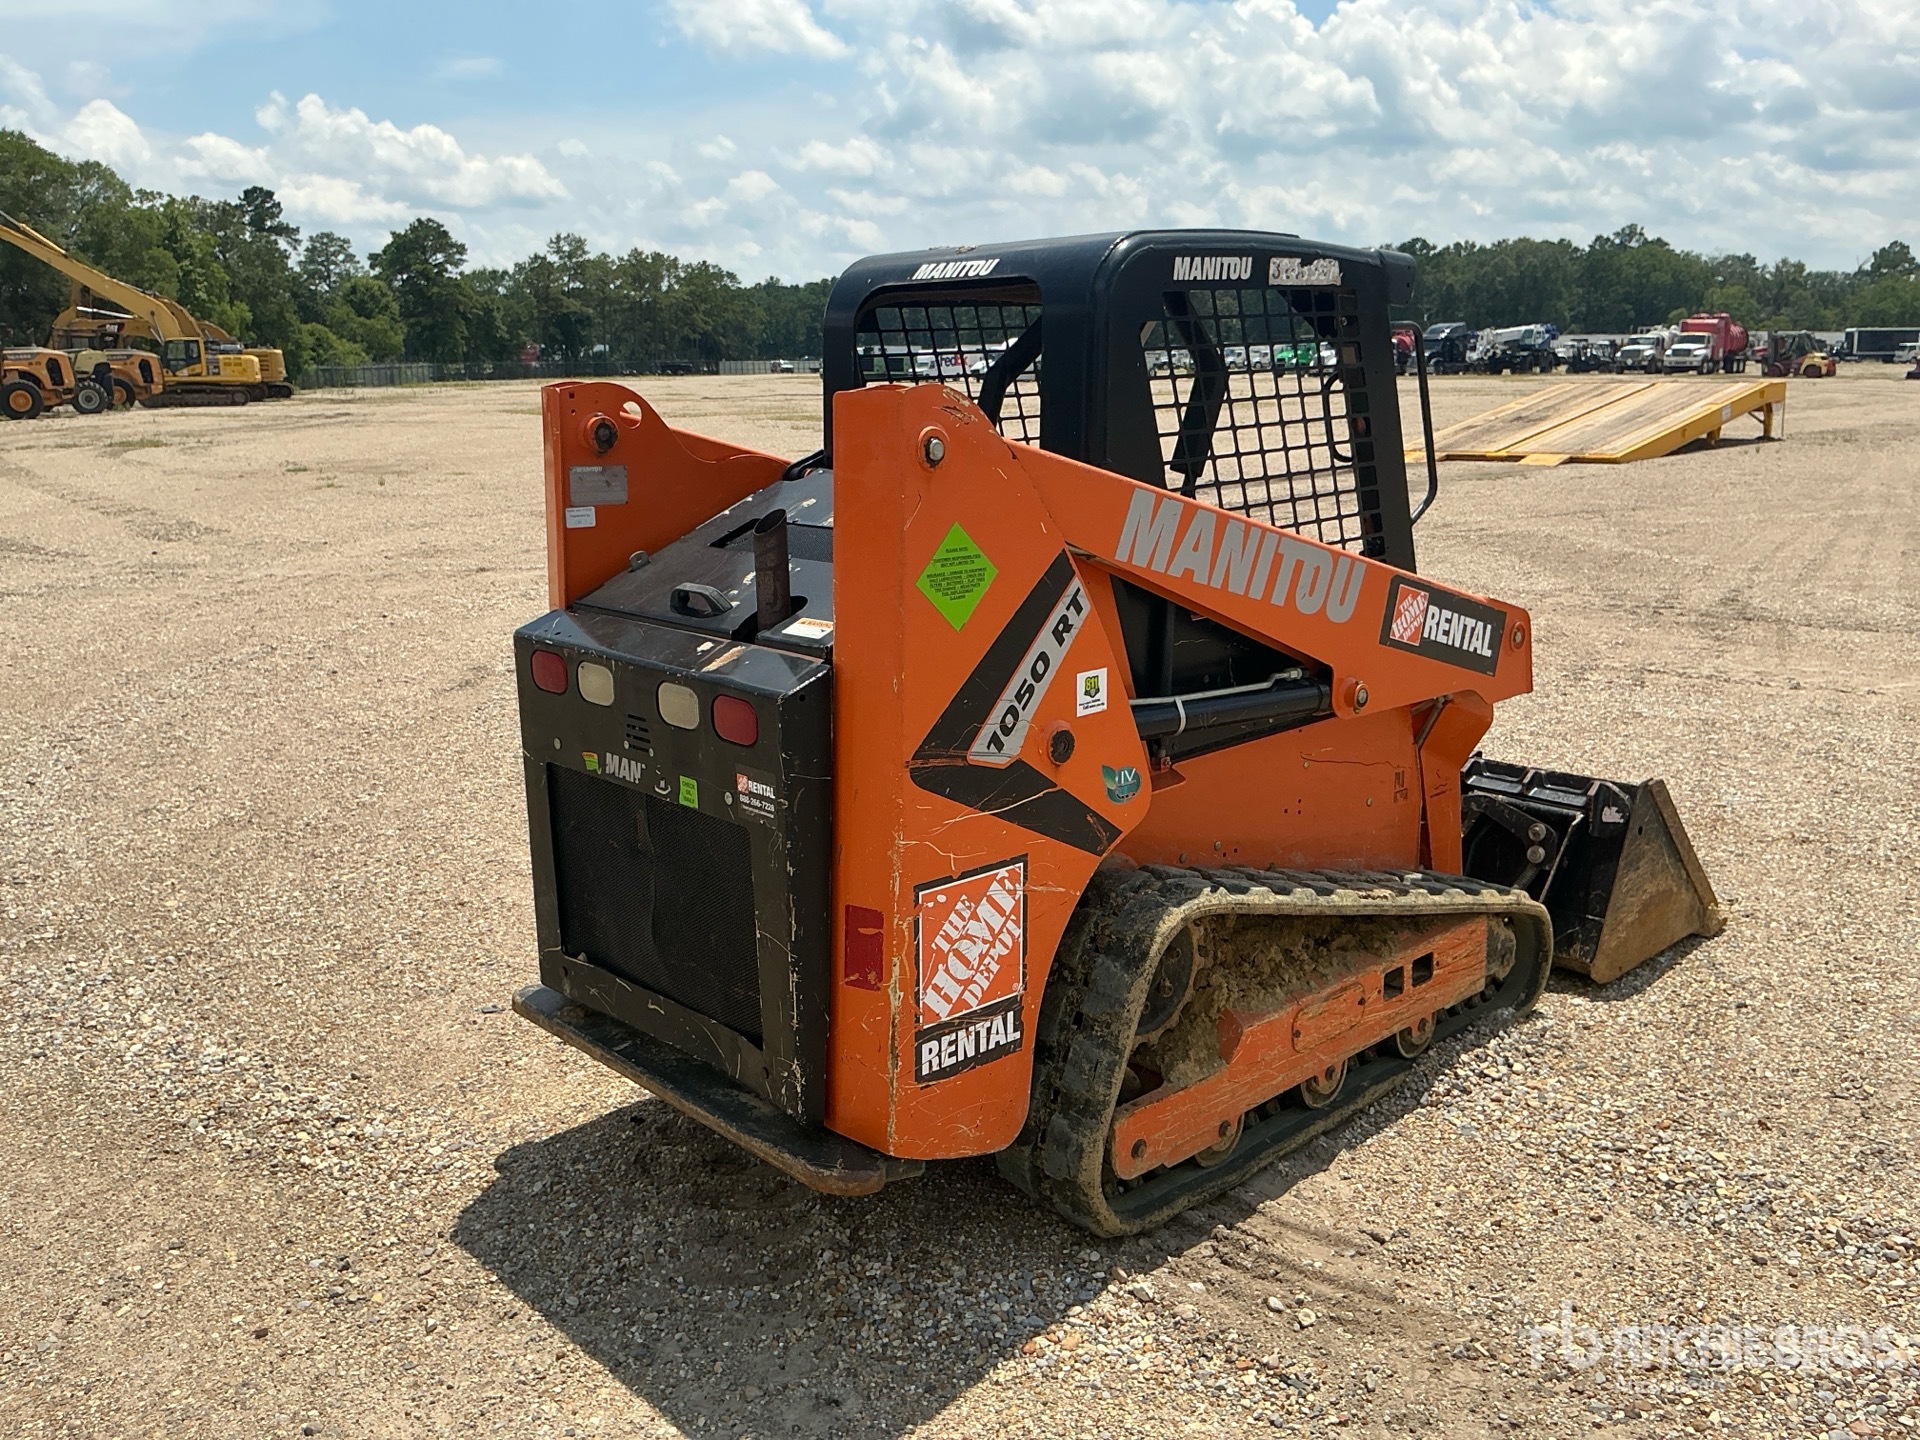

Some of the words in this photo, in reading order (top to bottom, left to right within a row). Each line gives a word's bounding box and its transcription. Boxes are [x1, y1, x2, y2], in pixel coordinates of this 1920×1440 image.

[911, 258, 1000, 280] MANITOU
[1173, 256, 1253, 280] MANITOU
[1114, 487, 1367, 624] MANITOU
[1391, 591, 1427, 639] HOME
[1399, 593, 1414, 613] THE
[1402, 611, 1425, 641] DEPOT
[1423, 604, 1493, 658] RENTAL
[986, 650, 1050, 754] 1050
[1051, 586, 1084, 648] RT
[1085, 675, 1099, 691] 811
[748, 780, 776, 799] RENTAL
[922, 869, 1022, 1019] HOME
[931, 894, 977, 955] THE
[962, 914, 1023, 1009] DEPOT
[921, 1010, 1021, 1077] RENTAL
